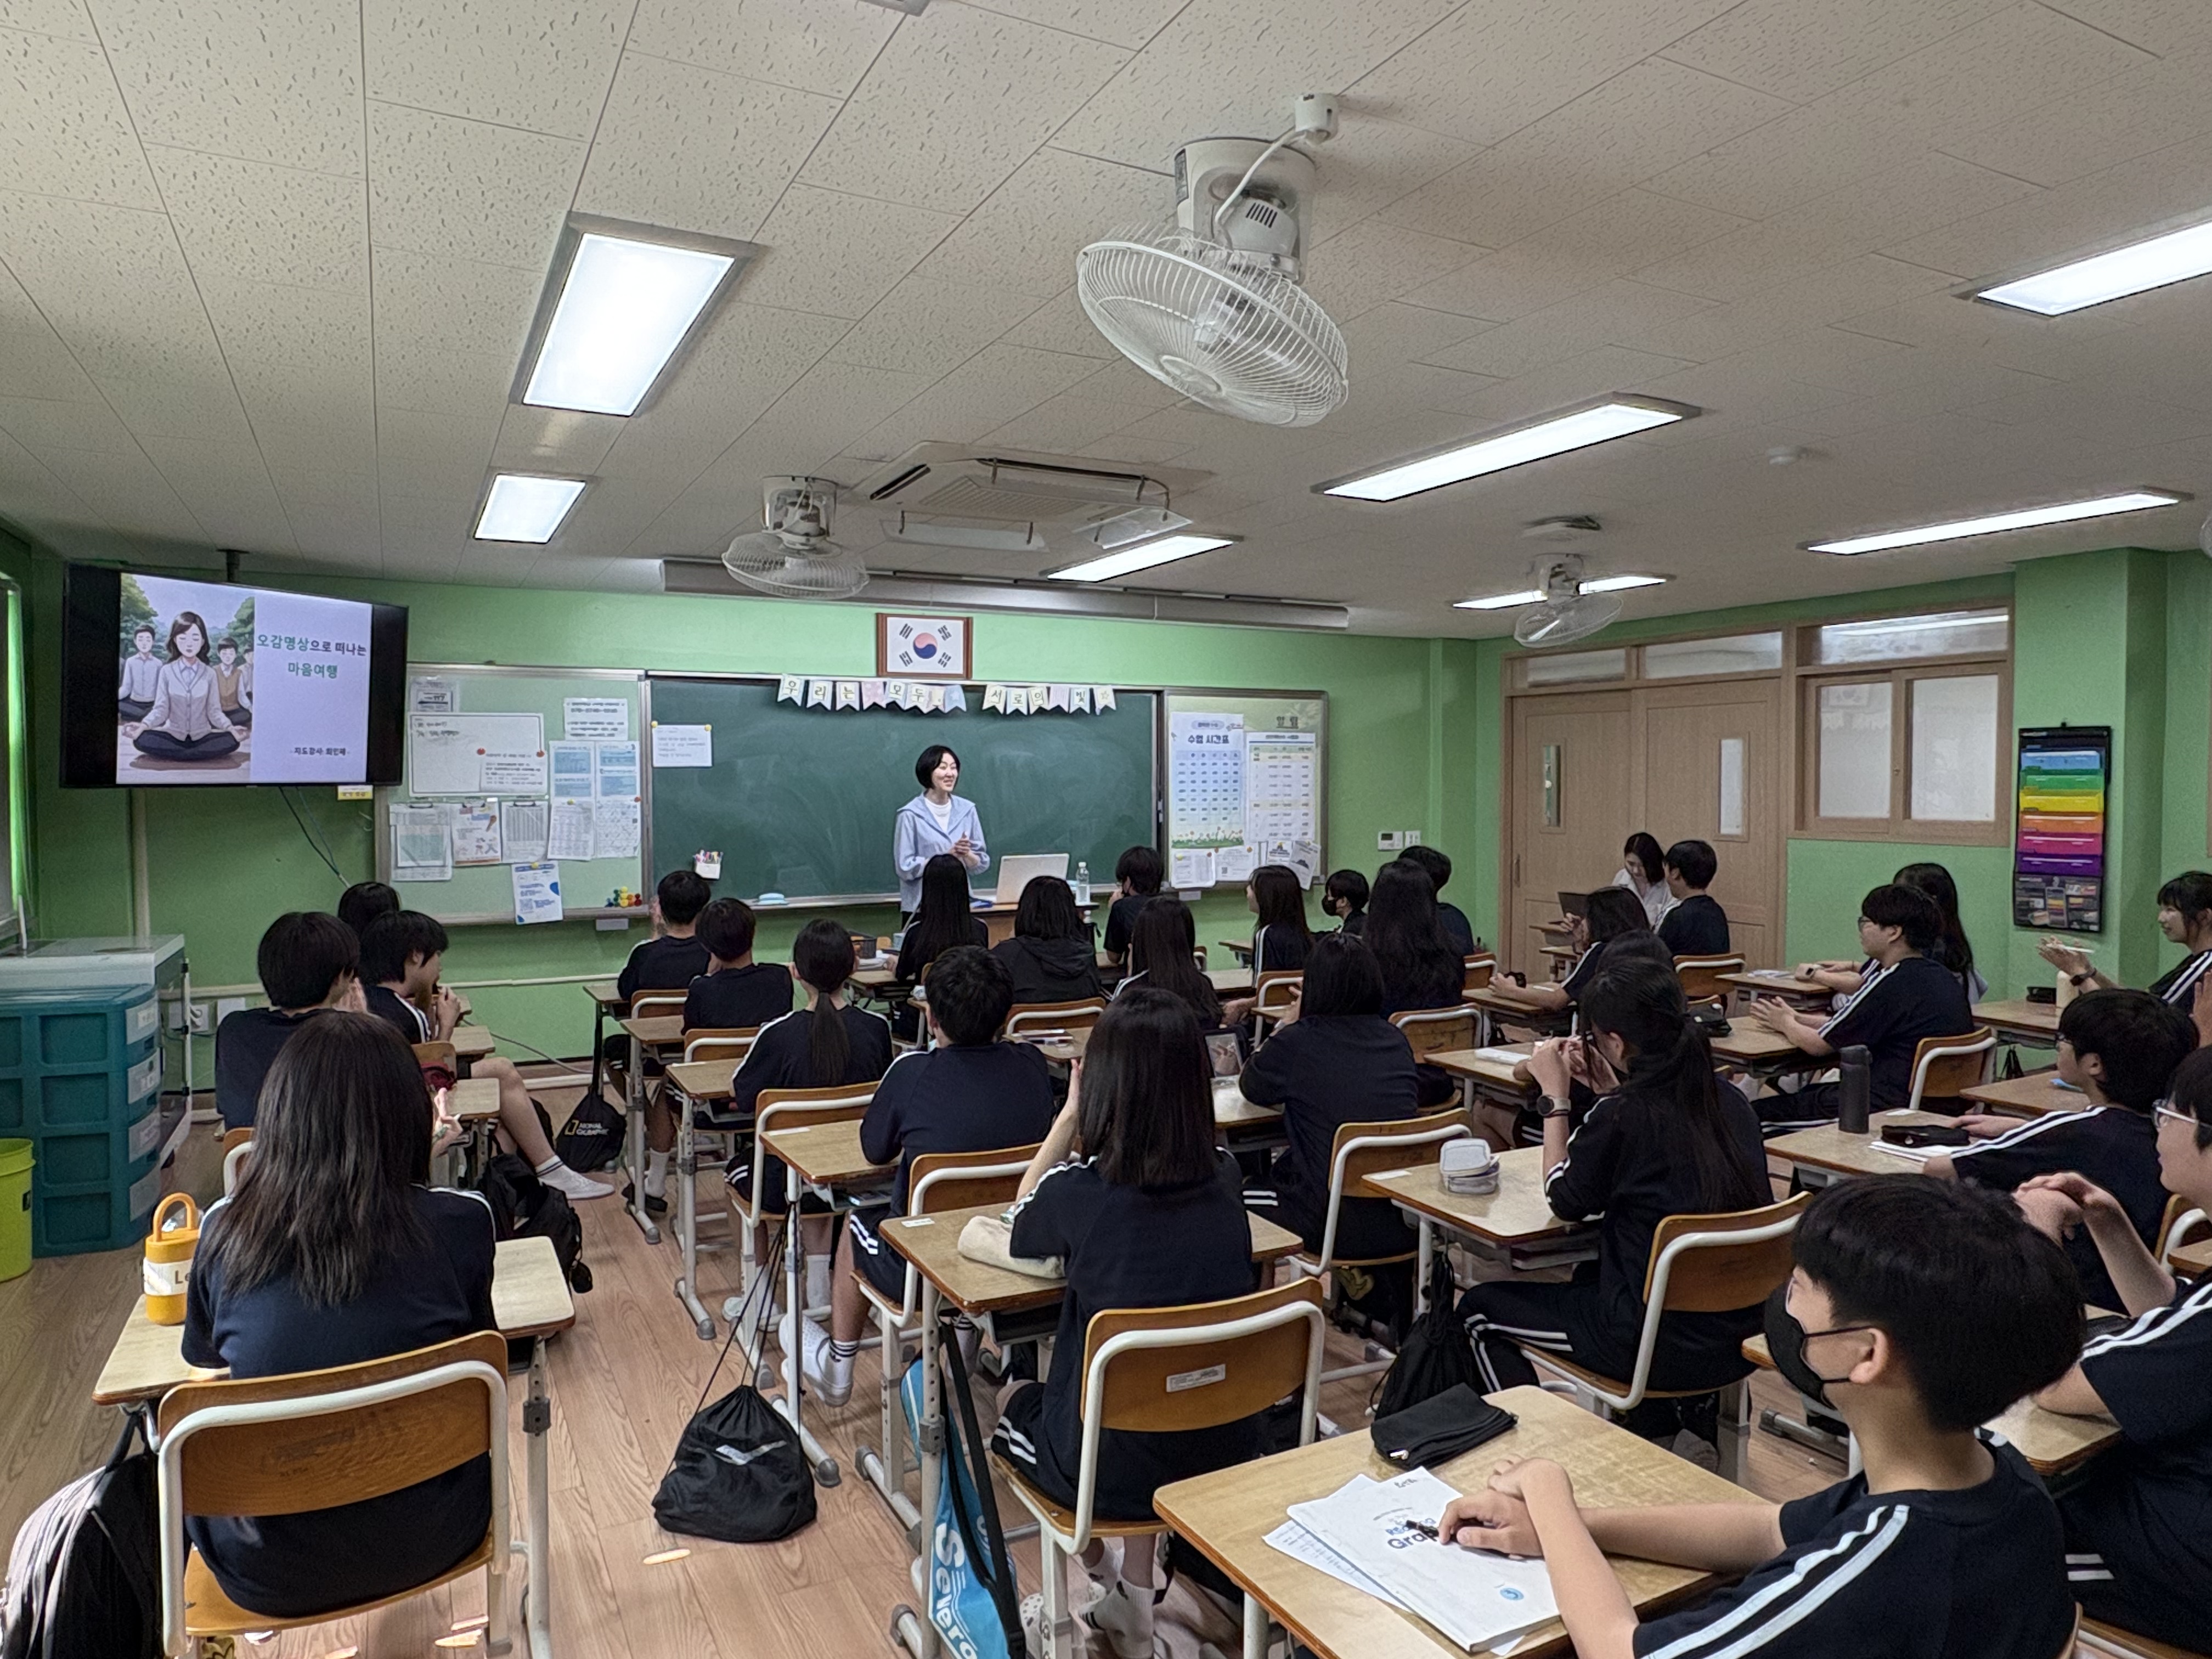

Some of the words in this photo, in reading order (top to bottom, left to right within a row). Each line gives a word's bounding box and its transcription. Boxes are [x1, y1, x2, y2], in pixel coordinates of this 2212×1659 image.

[257, 634, 332, 652] 오감명상으로
[335, 641, 366, 656] 떠나는
[288, 662, 337, 679] 마음여행
[788, 680, 854, 701] 우리는
[889, 681, 926, 702] 모두
[991, 689, 1043, 707] 서로의
